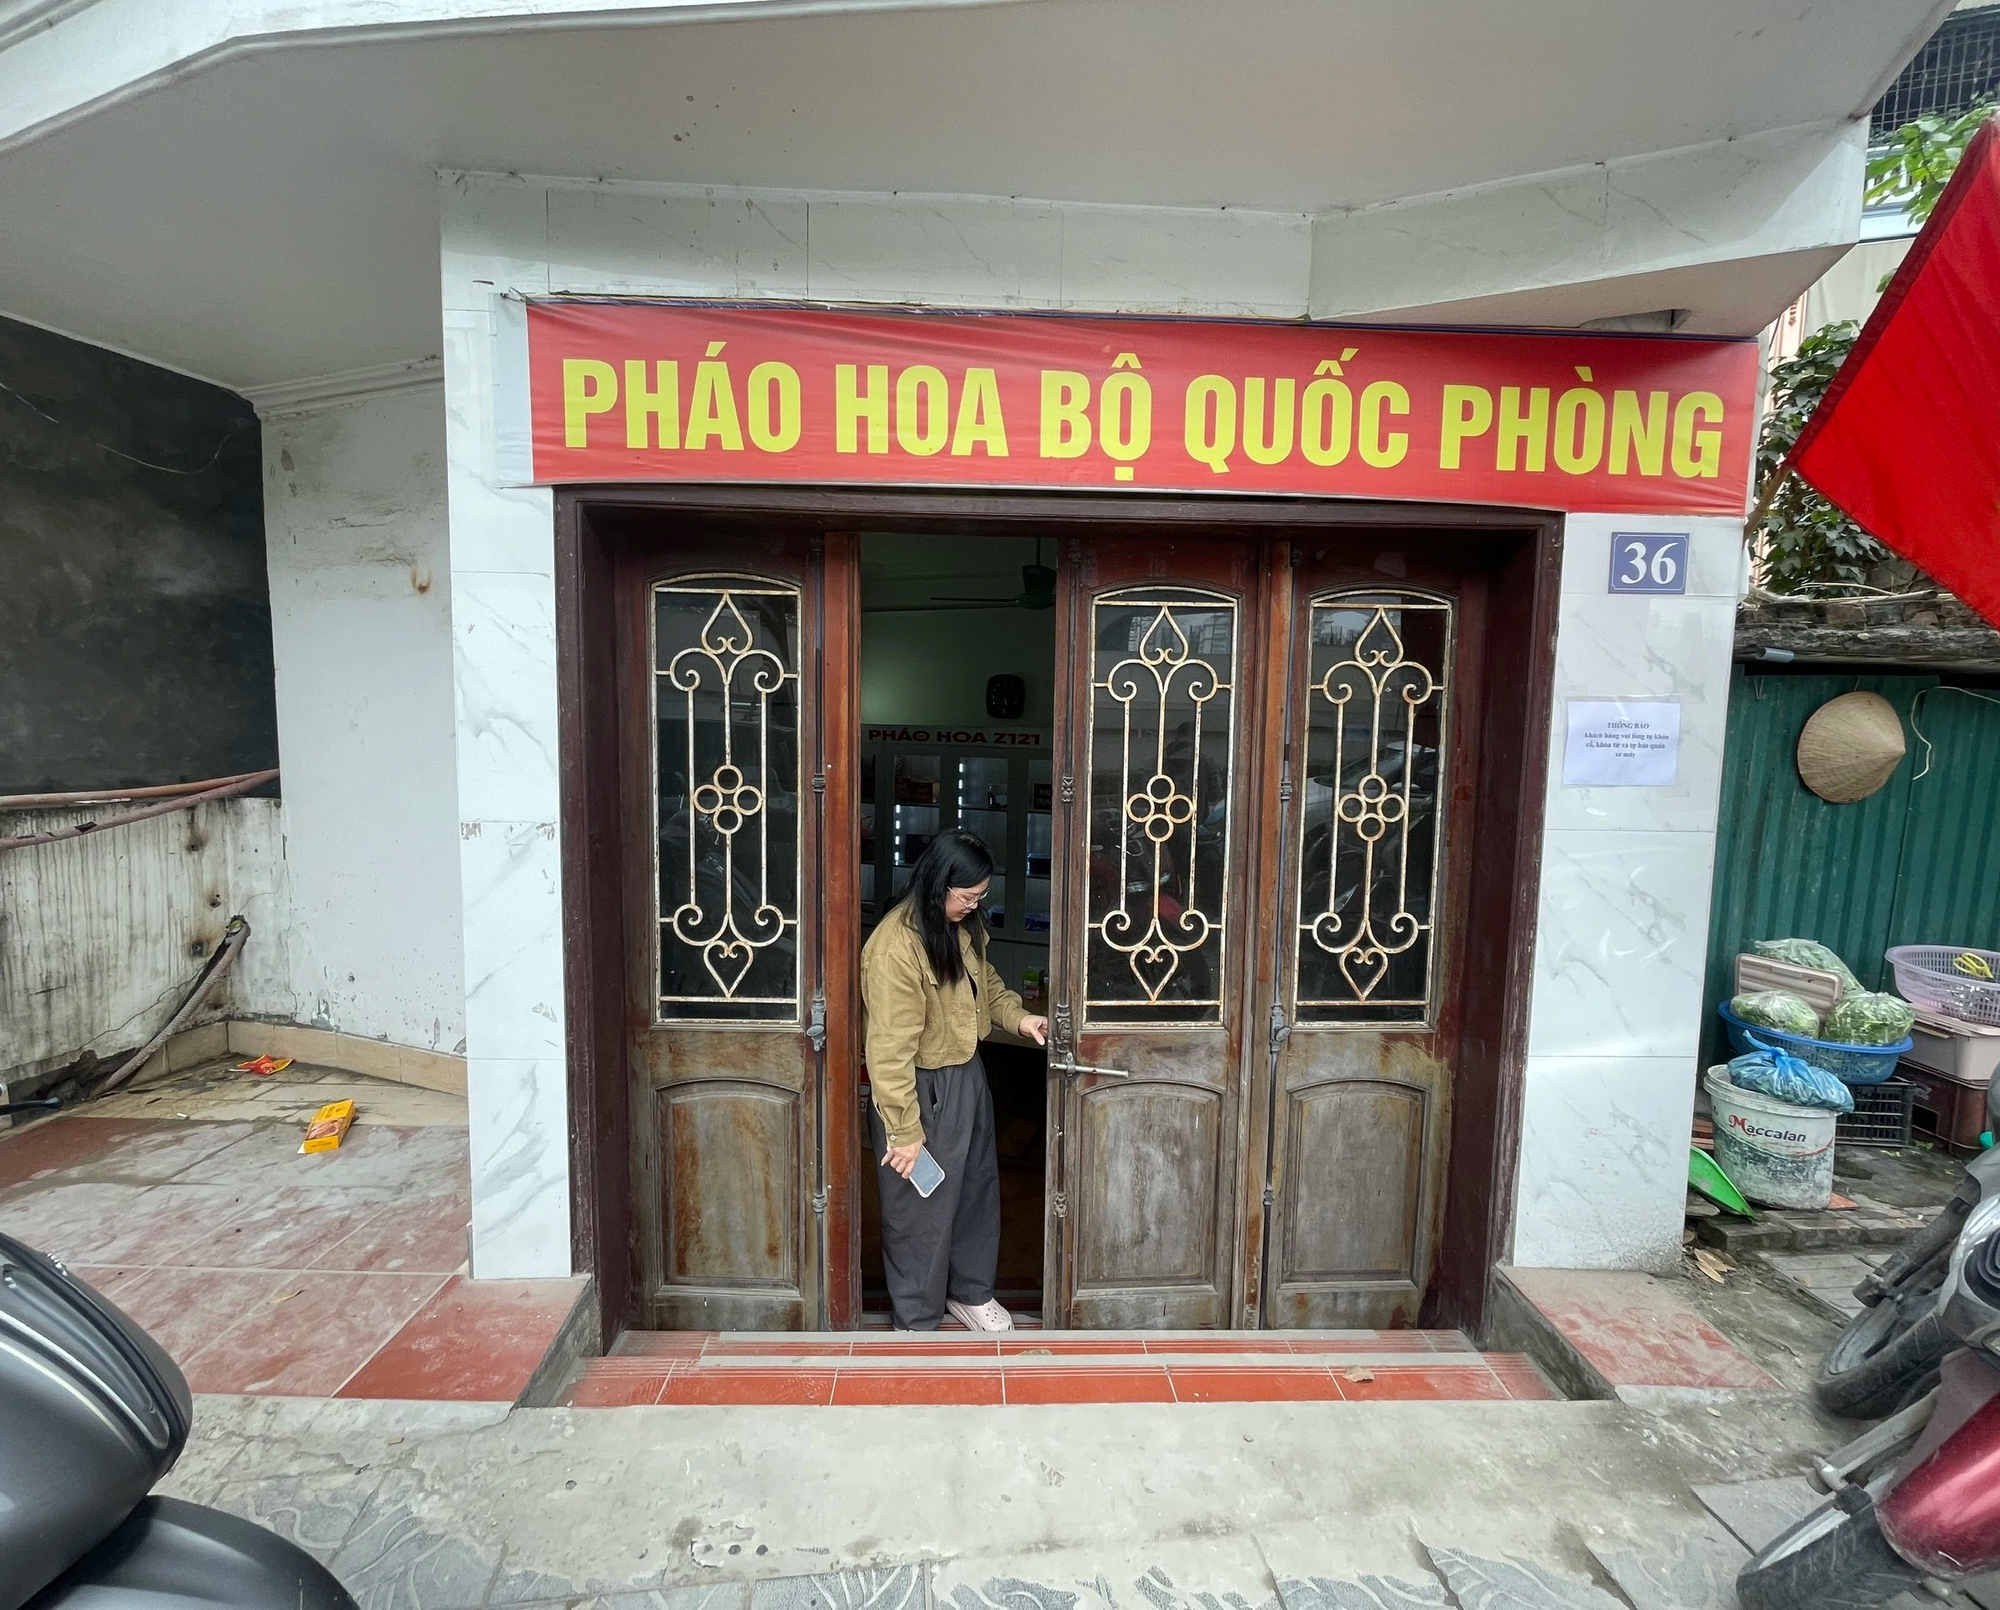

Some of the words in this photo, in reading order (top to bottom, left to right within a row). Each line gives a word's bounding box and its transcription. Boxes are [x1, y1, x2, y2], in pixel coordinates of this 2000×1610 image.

[563, 341, 802, 452] PHÁO
[835, 363, 1010, 457] HOA
[1040, 352, 1151, 481] BỘ
[1184, 348, 1411, 474] QUỐC
[1440, 366, 1725, 479] PHÒNG
[1621, 542, 1679, 584] 36
[868, 727, 931, 742] PHÁO
[936, 731, 988, 743] HOA
[993, 732, 1041, 745] Z121
[1728, 1114, 1807, 1142] Maccalan
